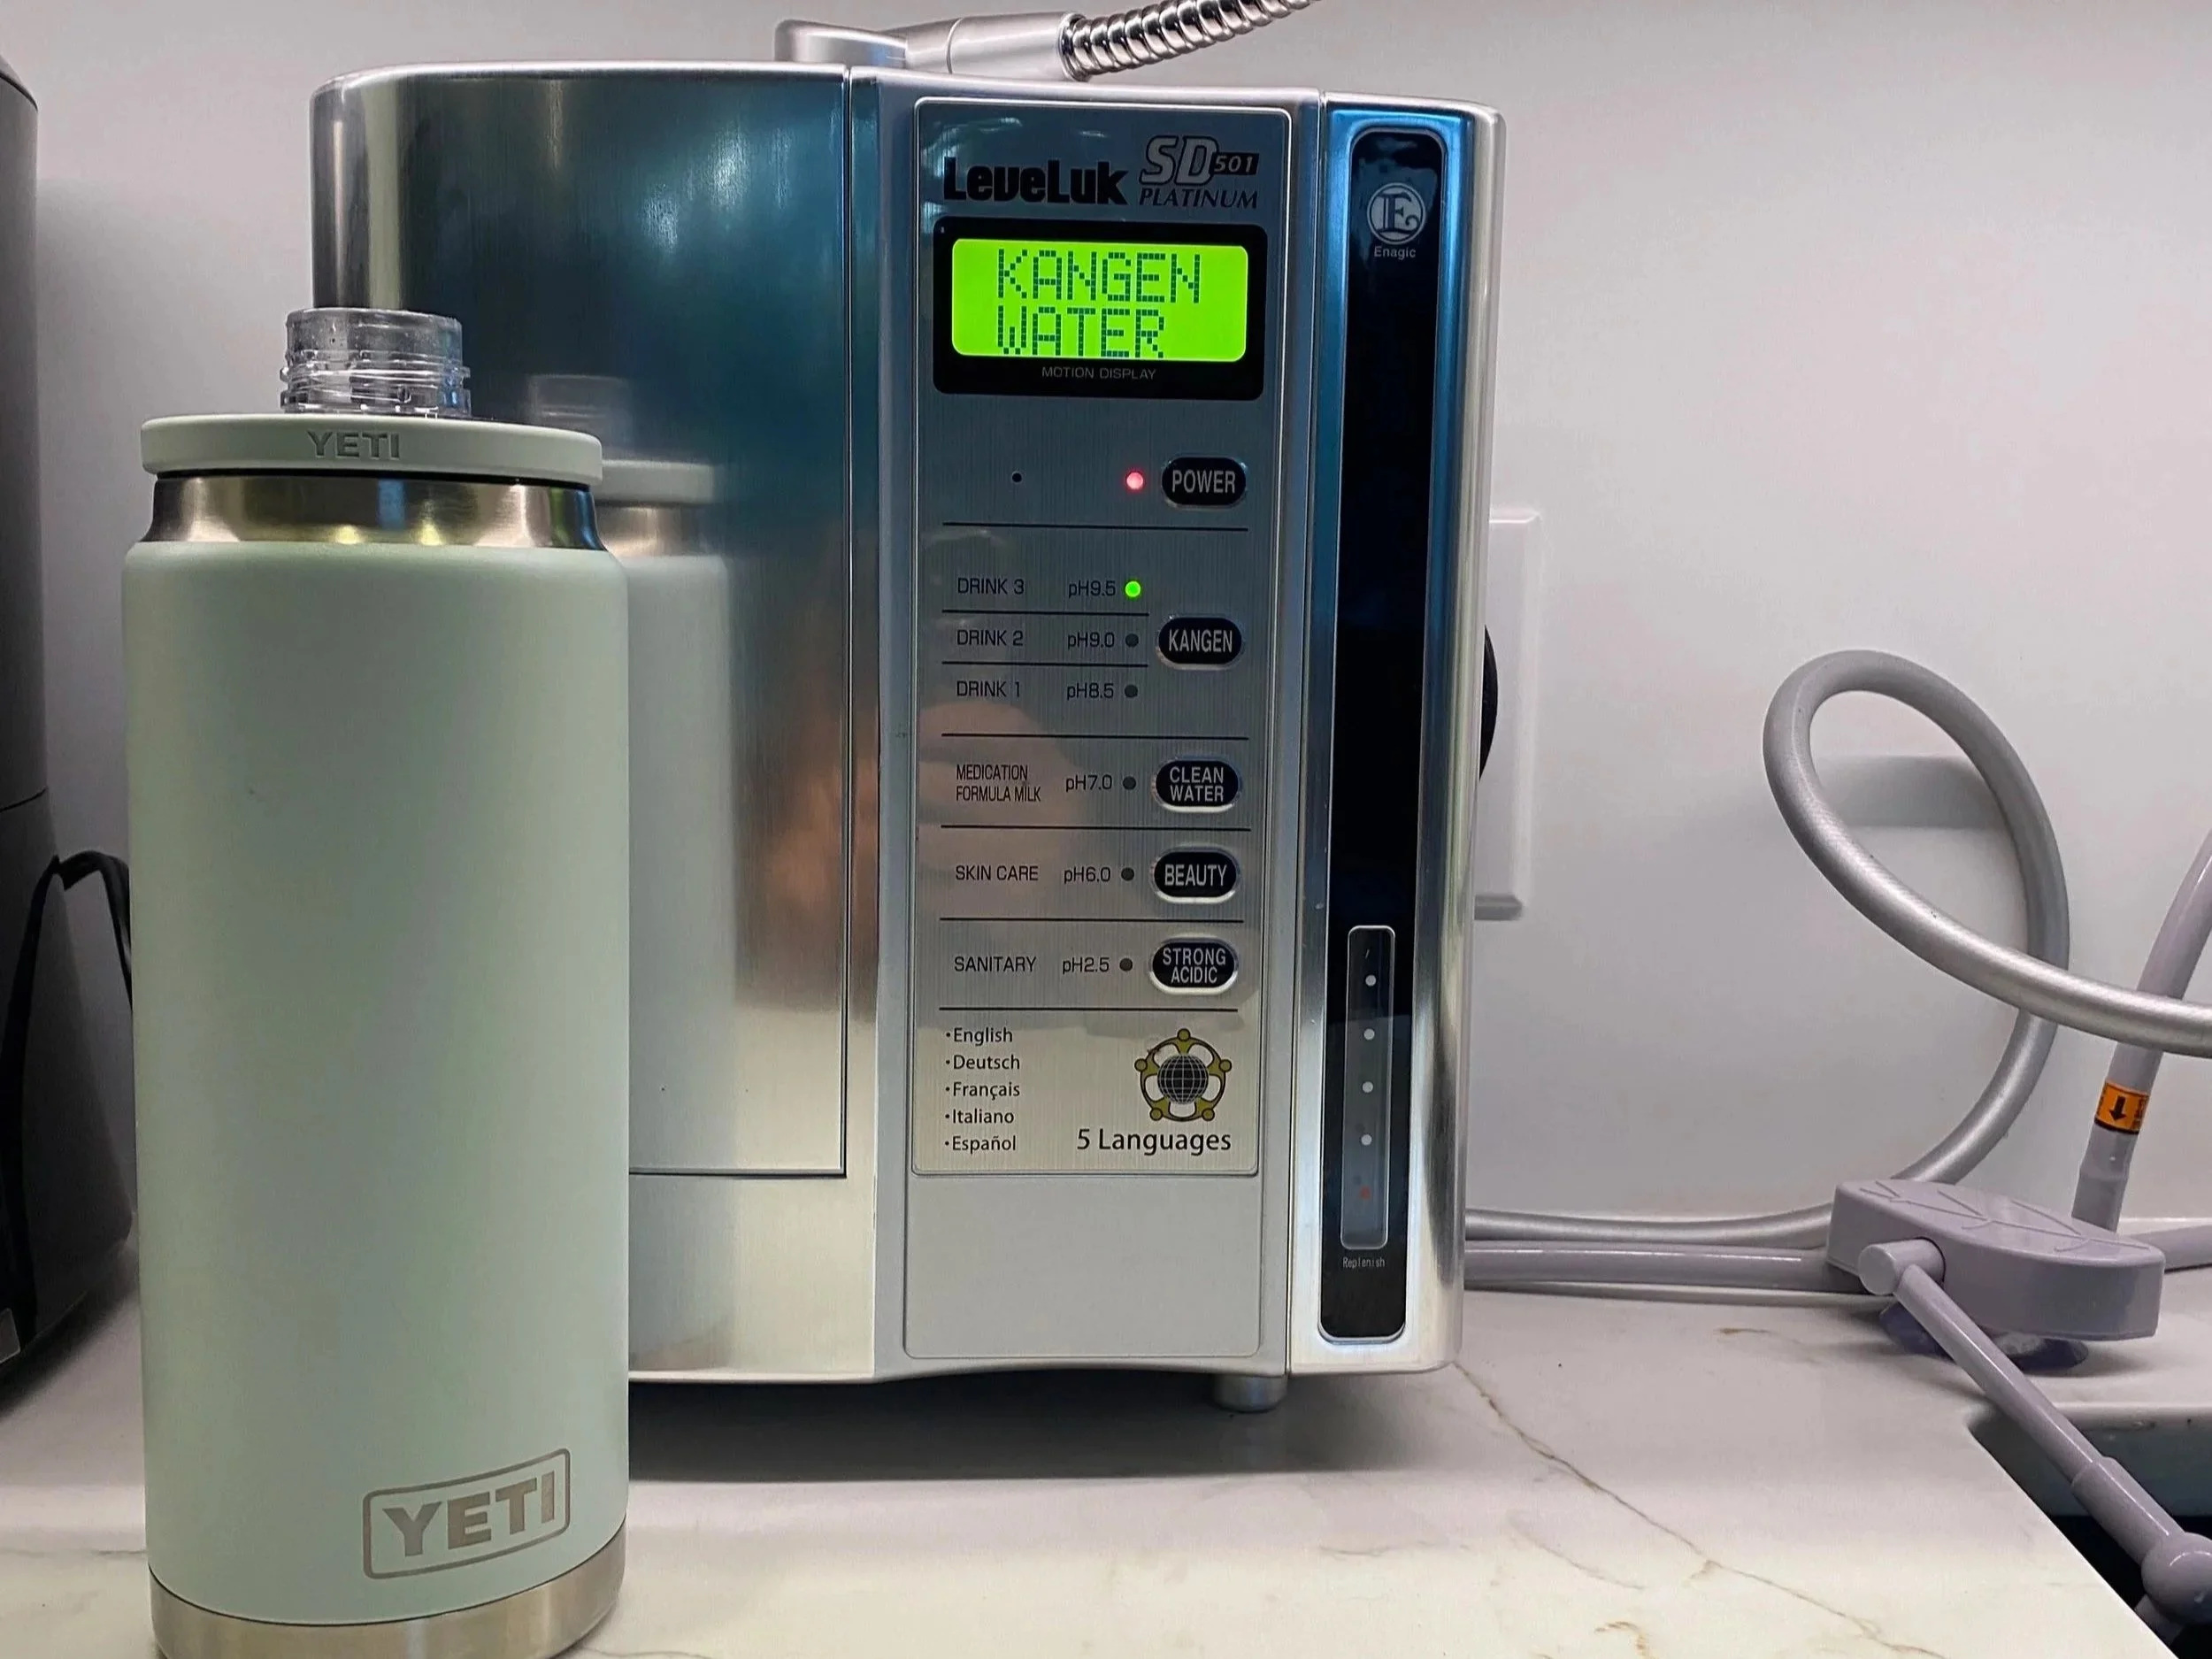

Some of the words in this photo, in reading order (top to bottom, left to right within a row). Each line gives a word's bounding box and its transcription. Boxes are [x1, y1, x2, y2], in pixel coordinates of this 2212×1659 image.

[1214, 155, 1254, 173] 501
[1139, 188, 1259, 209] PLATINUM
[1373, 245, 1417, 260] Enagic
[997, 249, 1201, 303] KANGEN
[997, 305, 1164, 359] WATER
[1041, 366, 1095, 380] MOTION
[1099, 367, 1156, 380] DISPLAY
[306, 431, 402, 461] YETI
[1171, 470, 1236, 494] POWER
[956, 578, 1008, 595] DRINK
[1013, 578, 1025, 595] 3
[1068, 580, 1116, 597] pH9.5
[956, 629, 1007, 647] DRINK
[1012, 629, 1024, 647] 2
[1067, 632, 1115, 649] pH9.0
[1168, 629, 1233, 652] KANGEN
[956, 680, 1006, 697] DRINK
[1014, 680, 1020, 697] 1
[1066, 682, 1114, 700] pH8.5
[956, 764, 1028, 780] MEDICATION
[1169, 766, 1225, 784] CLEAN
[1065, 775, 1113, 792] pH7.0
[956, 786, 1011, 802] FORMULA
[1014, 786, 1041, 803] MILK
[1170, 785, 1225, 803] WATER
[955, 864, 992, 881] SKIN
[996, 865, 1039, 881] CARE
[1064, 866, 1111, 884] pH6.0
[1164, 864, 1228, 886] BEAUTY
[954, 956, 1037, 972] SANITARY
[1062, 957, 1110, 975] pH2.5
[1162, 948, 1226, 966] STRONG
[1171, 966, 1218, 984] ACIDIC
[1077, 1128, 1091, 1151] 5
[1098, 1129, 1232, 1156] Languages
[1342, 1256, 1386, 1269] Replenish
[381, 1470, 555, 1557] YETI
